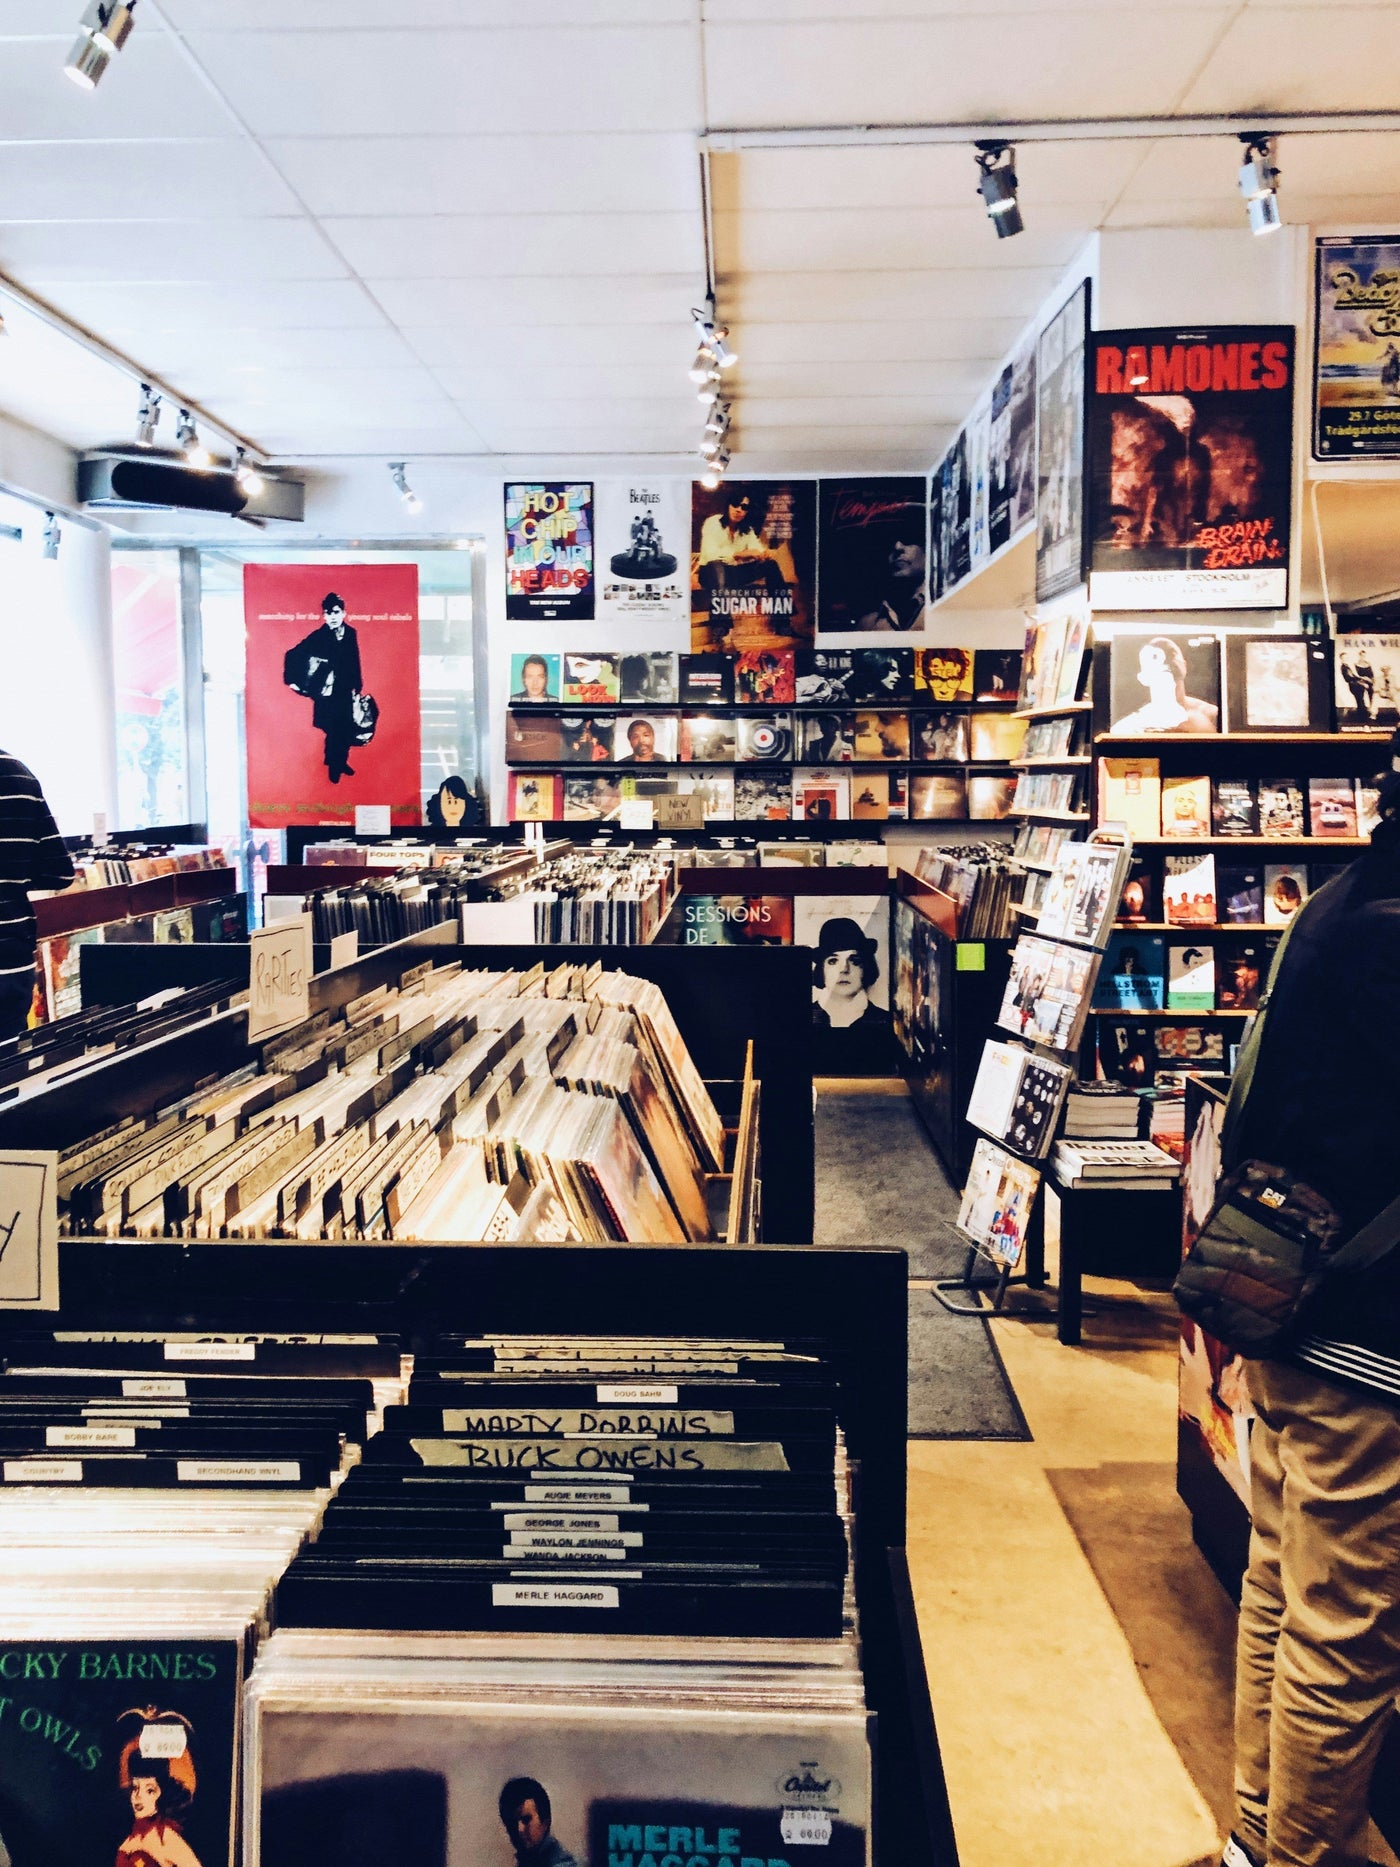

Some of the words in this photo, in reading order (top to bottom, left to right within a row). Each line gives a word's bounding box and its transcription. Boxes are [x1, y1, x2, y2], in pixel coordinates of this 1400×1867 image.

[1096, 342, 1288, 393] RAMONES
[523, 492, 576, 514] HOT
[630, 489, 661, 505] BEATLES
[520, 517, 578, 540] CHIP
[1198, 518, 1275, 549] BRAIN
[514, 546, 536, 564] IN
[538, 545, 587, 565] OUR
[1204, 538, 1285, 569] DRAIN
[511, 568, 589, 588] HEADS
[711, 597, 758, 615] SUGAR
[760, 597, 793, 615] MAN
[568, 684, 608, 696] LOOK
[668, 797, 690, 808] NEW
[685, 906, 772, 923] SESSIONS
[686, 928, 708, 944] DE
[1064, 1142, 1147, 1151] Ikoner
[461, 1444, 562, 1467] BUCK
[576, 1446, 705, 1468] OWENS
[197, 1467, 257, 1475] SECONDHAND
[524, 1519, 565, 1528] GEORGE
[569, 1519, 601, 1528] JONES
[531, 1538, 573, 1547] WAYLON
[576, 1539, 625, 1548] JENNINGS
[515, 1591, 549, 1600] MERLE
[554, 1592, 604, 1600] HAGGARD
[79, 1652, 217, 1681] BARNES
[19, 1705, 103, 1772] OWLS
[608, 1824, 741, 1855] MERLE
